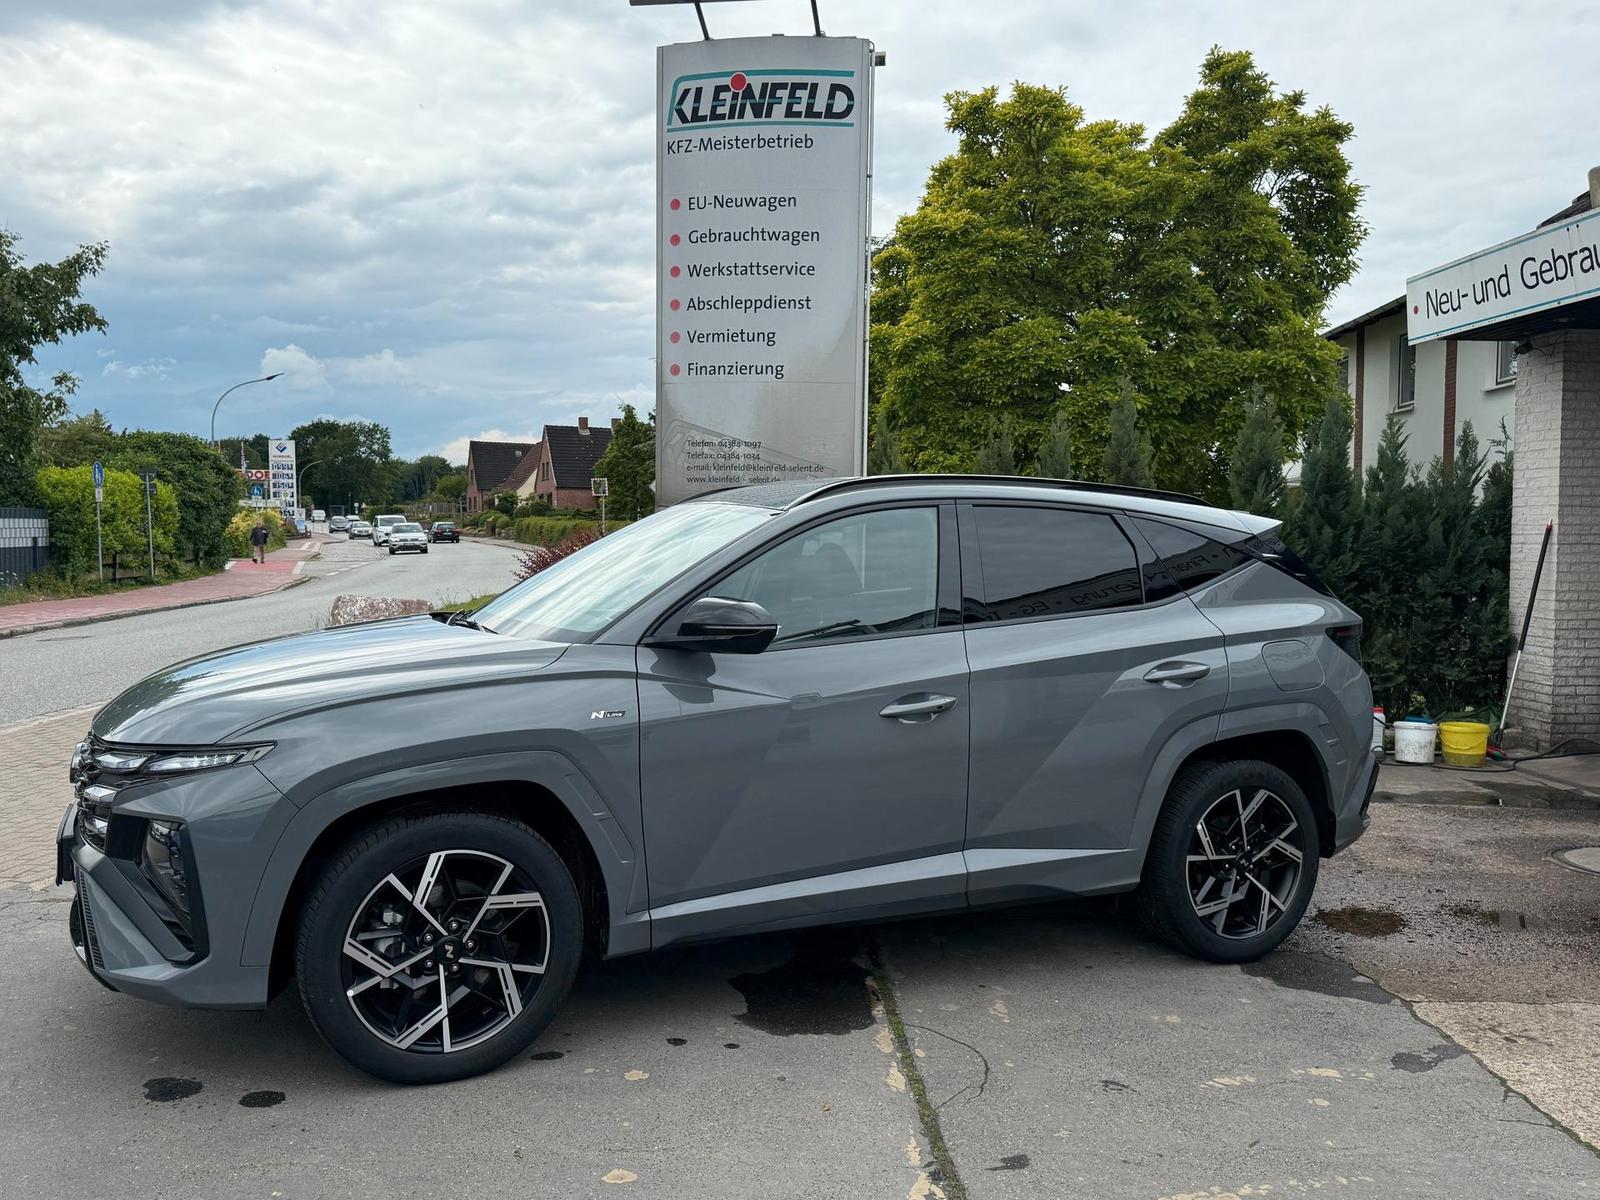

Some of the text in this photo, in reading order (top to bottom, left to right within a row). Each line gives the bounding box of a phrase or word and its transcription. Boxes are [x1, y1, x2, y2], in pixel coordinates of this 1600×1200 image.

[673, 72, 855, 124] KLEINFELD
[667, 133, 814, 155] KFZ-Meisterbetrieb
[688, 195, 797, 213] EU-Neuwagen
[688, 227, 820, 246] Gebrauchtwagen
[687, 261, 816, 278] Werkstattservice
[686, 295, 812, 314] Abschleppdienst
[687, 329, 776, 347] Vermietung
[687, 361, 785, 380] Finanzierung
[717, 439, 762, 449] 04384-1097
[687, 451, 760, 461] Telefax: 04384-1034
